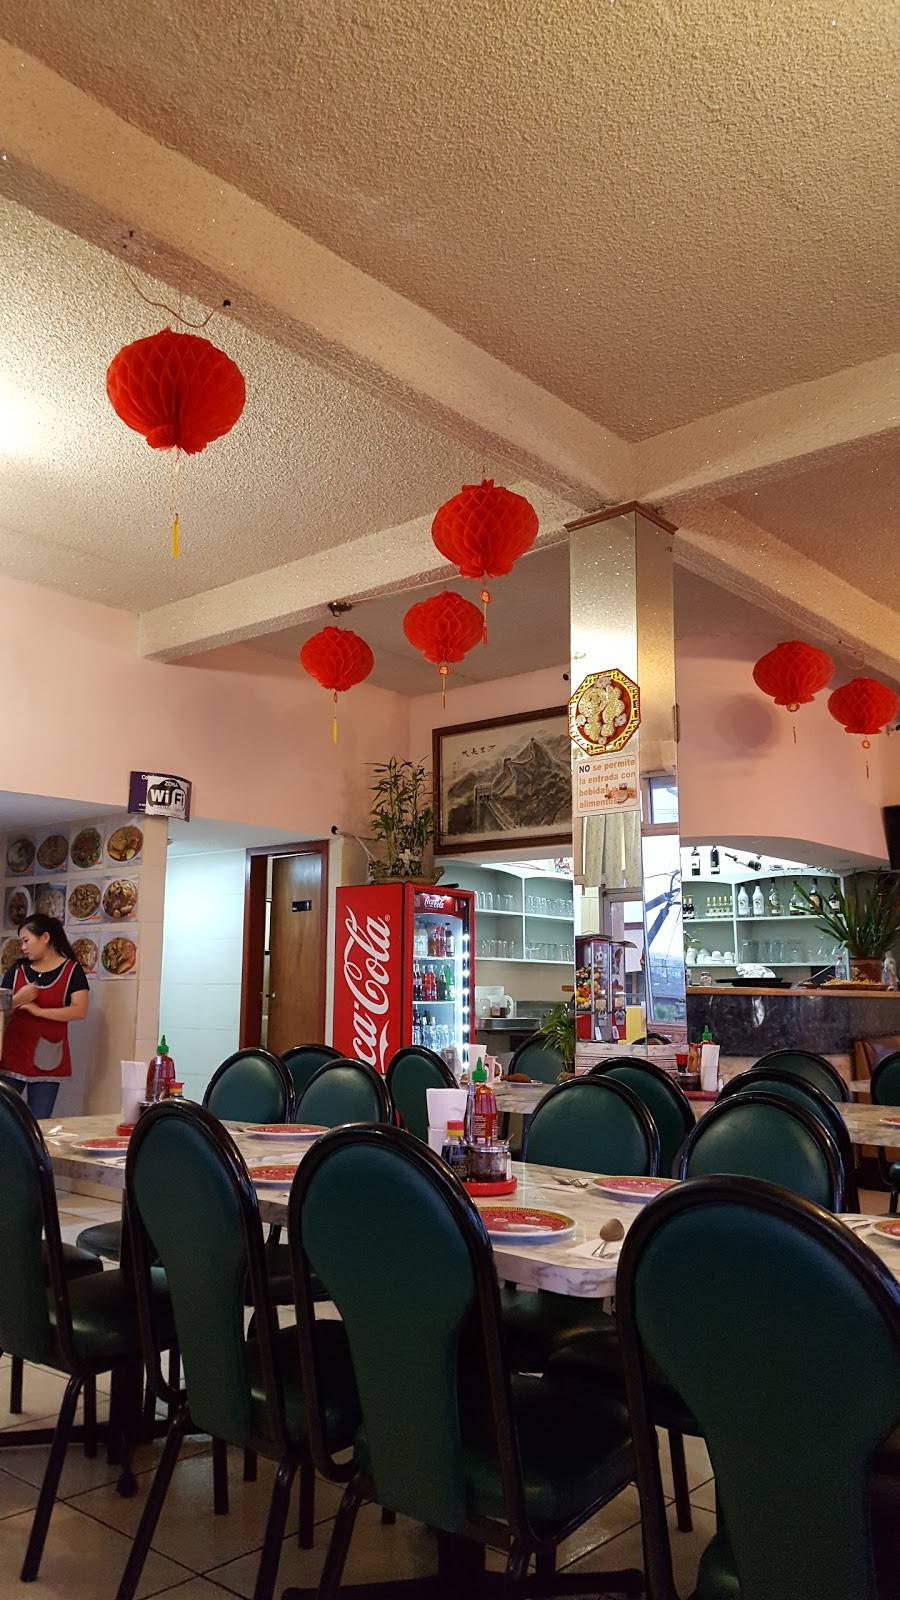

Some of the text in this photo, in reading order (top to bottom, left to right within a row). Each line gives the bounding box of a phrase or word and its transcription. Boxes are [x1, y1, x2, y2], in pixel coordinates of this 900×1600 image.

[579, 758, 635, 773] NO se permite
[164, 780, 179, 788] ZONA
[579, 771, 636, 785] la entrada con
[579, 798, 613, 809] alimento
[344, 905, 391, 1066] ca-Cola
